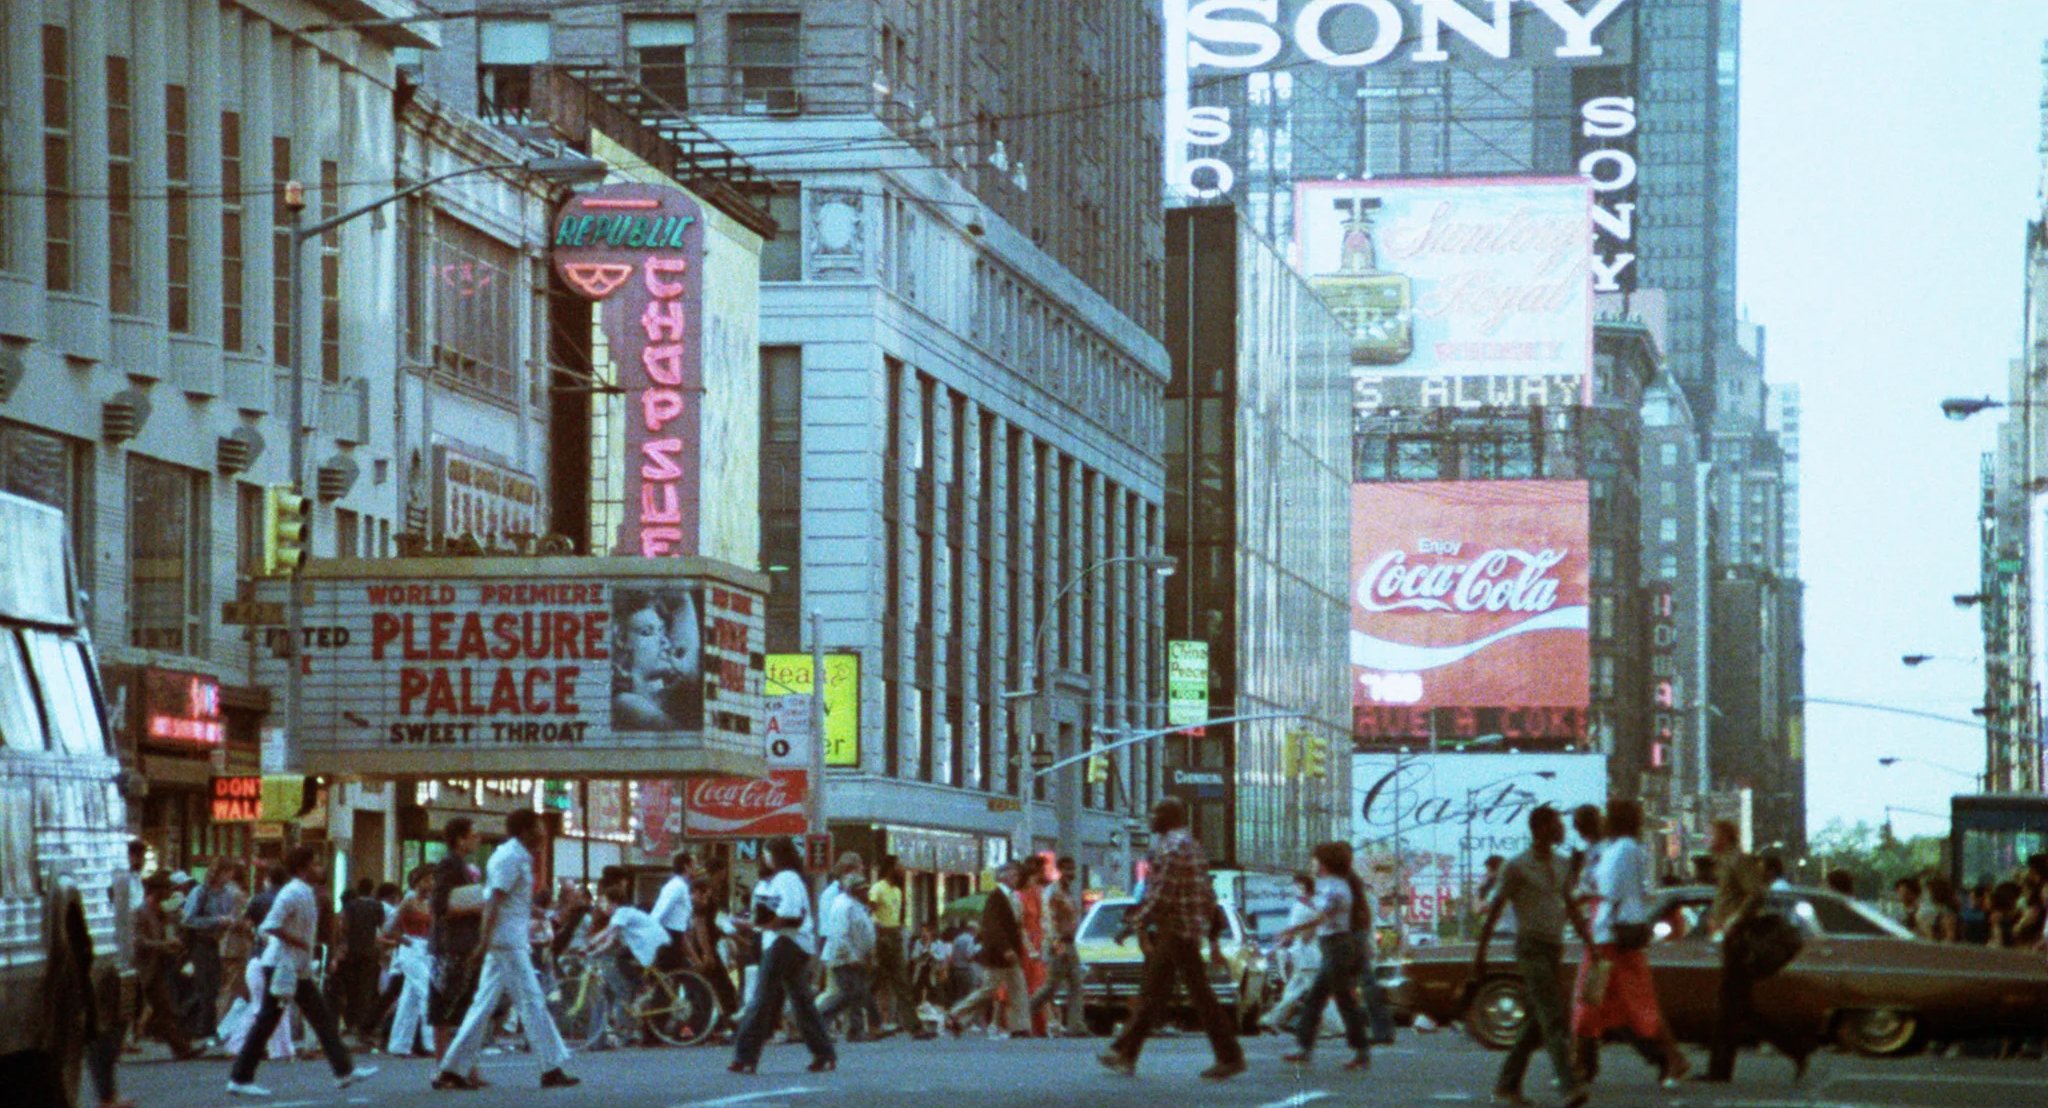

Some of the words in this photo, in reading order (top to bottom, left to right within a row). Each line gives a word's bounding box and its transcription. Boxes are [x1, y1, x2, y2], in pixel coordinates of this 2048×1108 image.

[1187, 0, 1623, 67] SONY
[556, 215, 696, 248] REPUBLIC
[641, 257, 685, 432] CHOP
[1418, 537, 1462, 555] Enjoy
[367, 585, 456, 605] WORLD
[481, 584, 604, 605] PREMIERE
[1356, 548, 1568, 613] Coca-Cola
[371, 611, 610, 660] PLEASURE
[400, 666, 581, 716] PALACE
[390, 723, 473, 743] SWEET
[490, 721, 589, 742] THROAT
[694, 778, 788, 808] Coca-Cola
